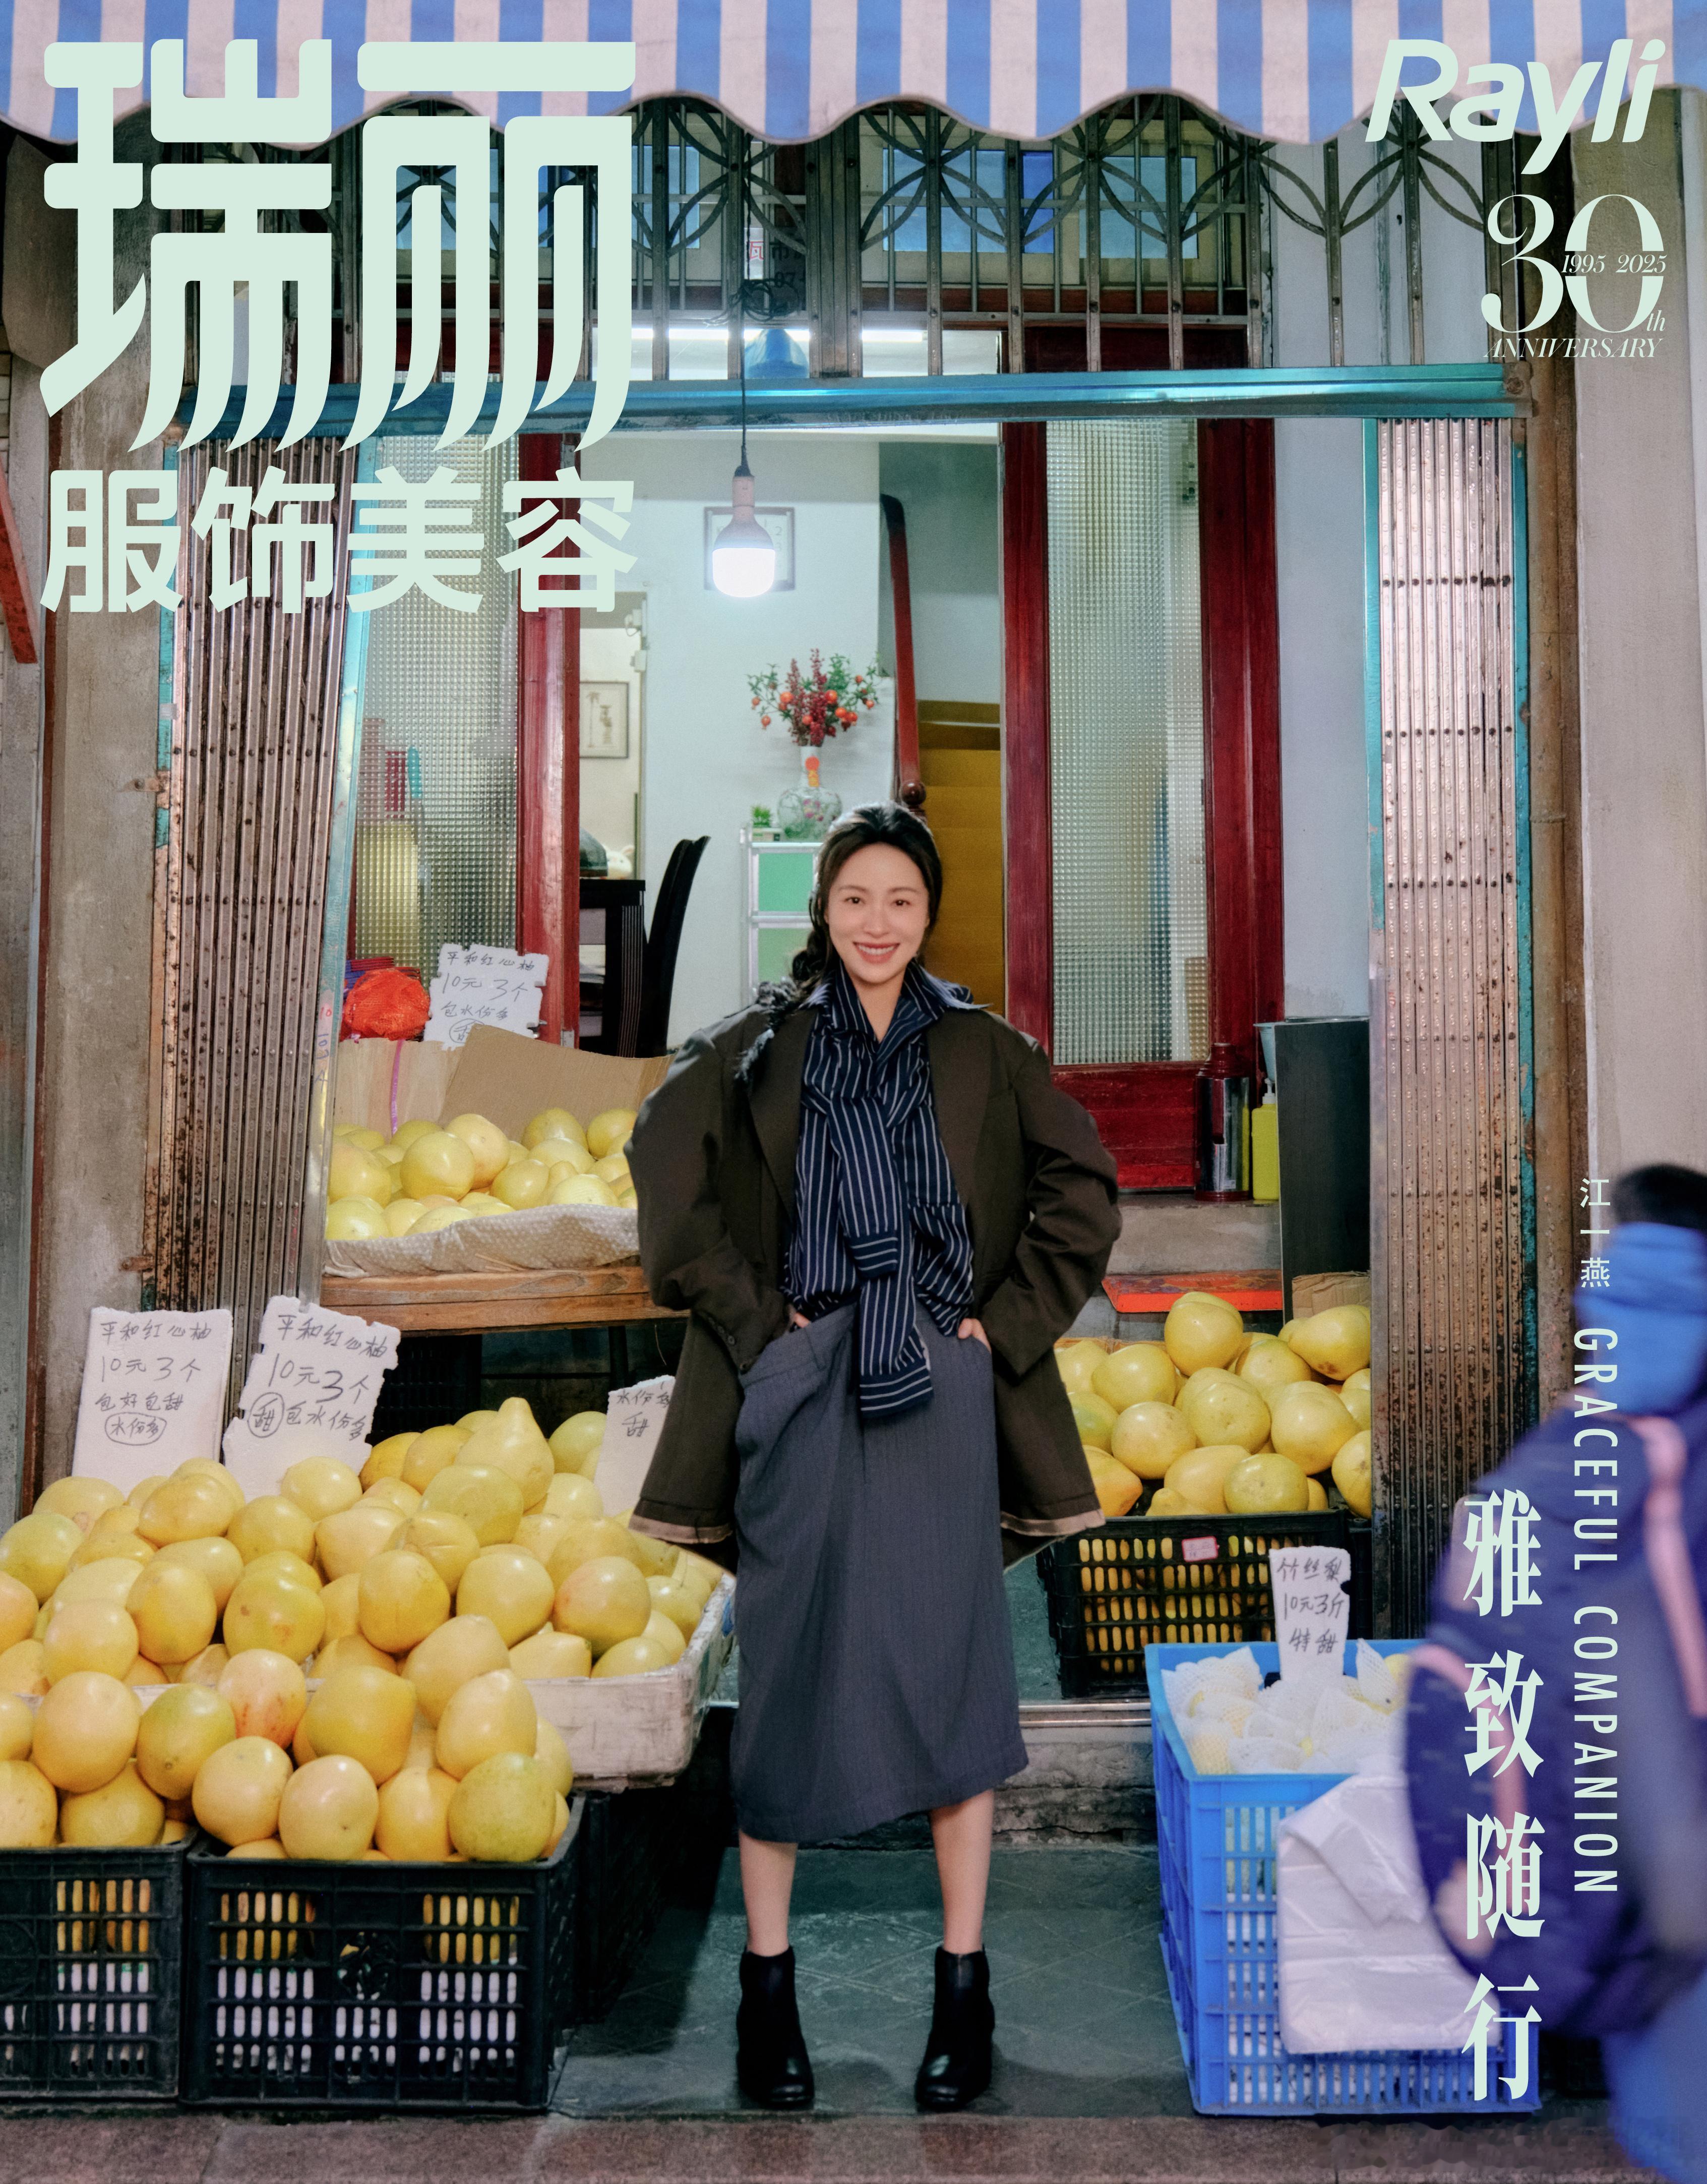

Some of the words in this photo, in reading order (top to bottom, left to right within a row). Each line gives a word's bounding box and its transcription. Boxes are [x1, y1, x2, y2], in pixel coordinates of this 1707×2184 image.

[448, 951, 534, 971] 平和红心柚
[101, 1319, 212, 1344] 平和红心柚
[278, 1315, 387, 1357] 平和红心柚
[111, 1416, 160, 1439] 水份多
[1289, 1628, 1338, 1655] 特甜
